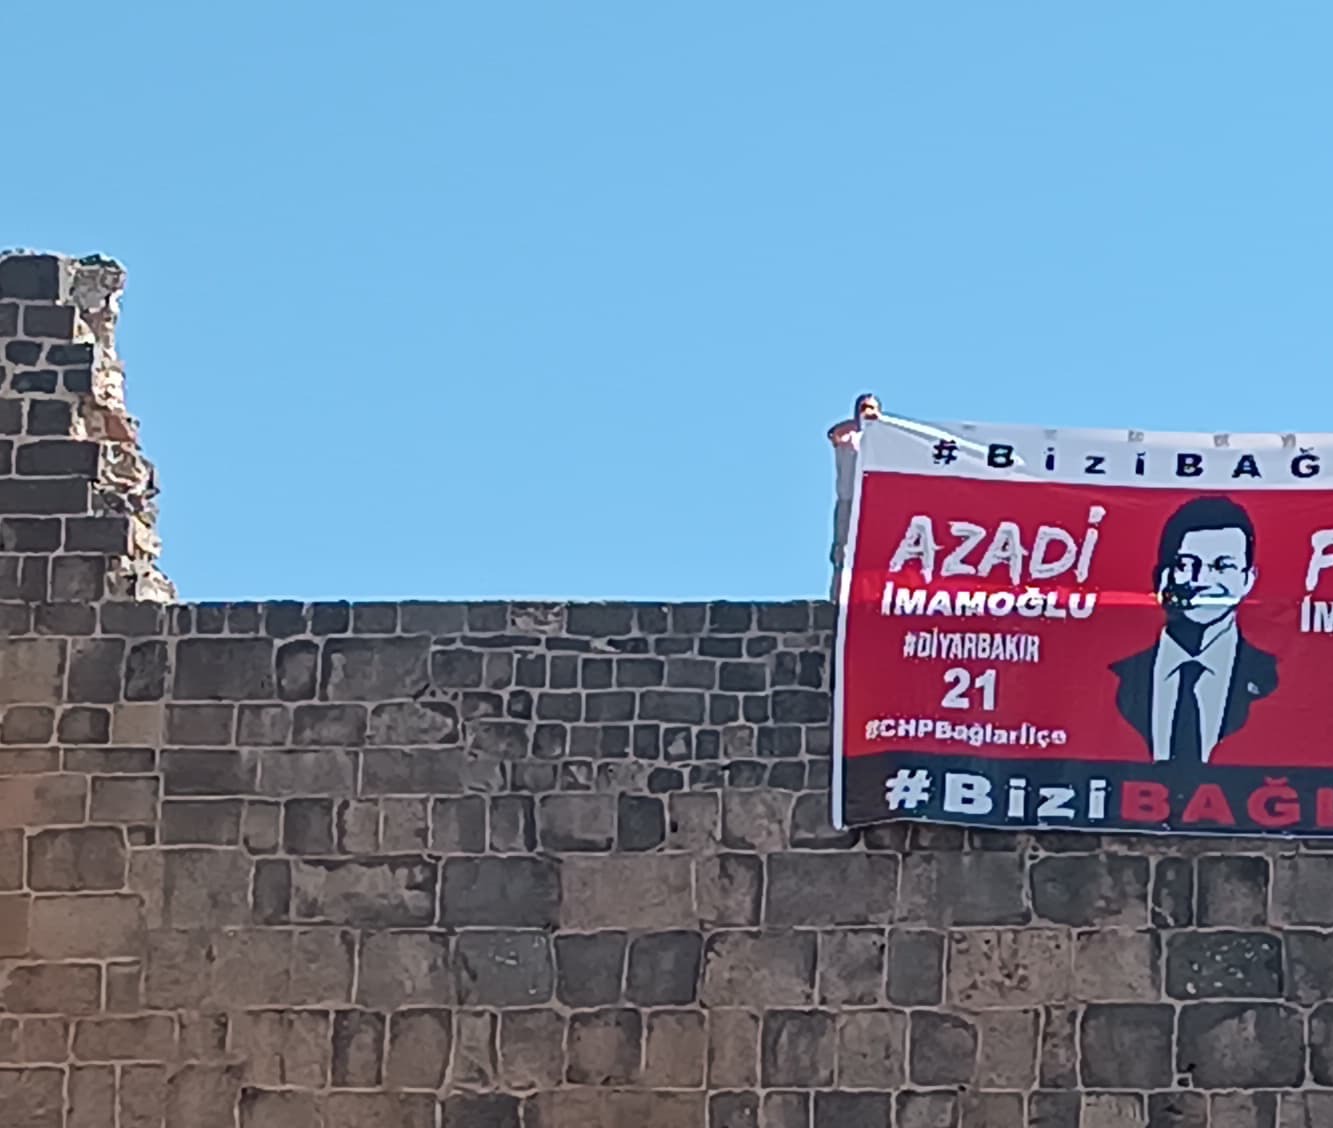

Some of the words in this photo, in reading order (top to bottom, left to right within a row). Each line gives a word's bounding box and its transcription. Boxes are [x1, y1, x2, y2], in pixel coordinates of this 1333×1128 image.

[881, 586, 1097, 620] İMAMOĞLU
[903, 627, 1040, 663] #DİYARBAKIR
[941, 667, 998, 711] 21
